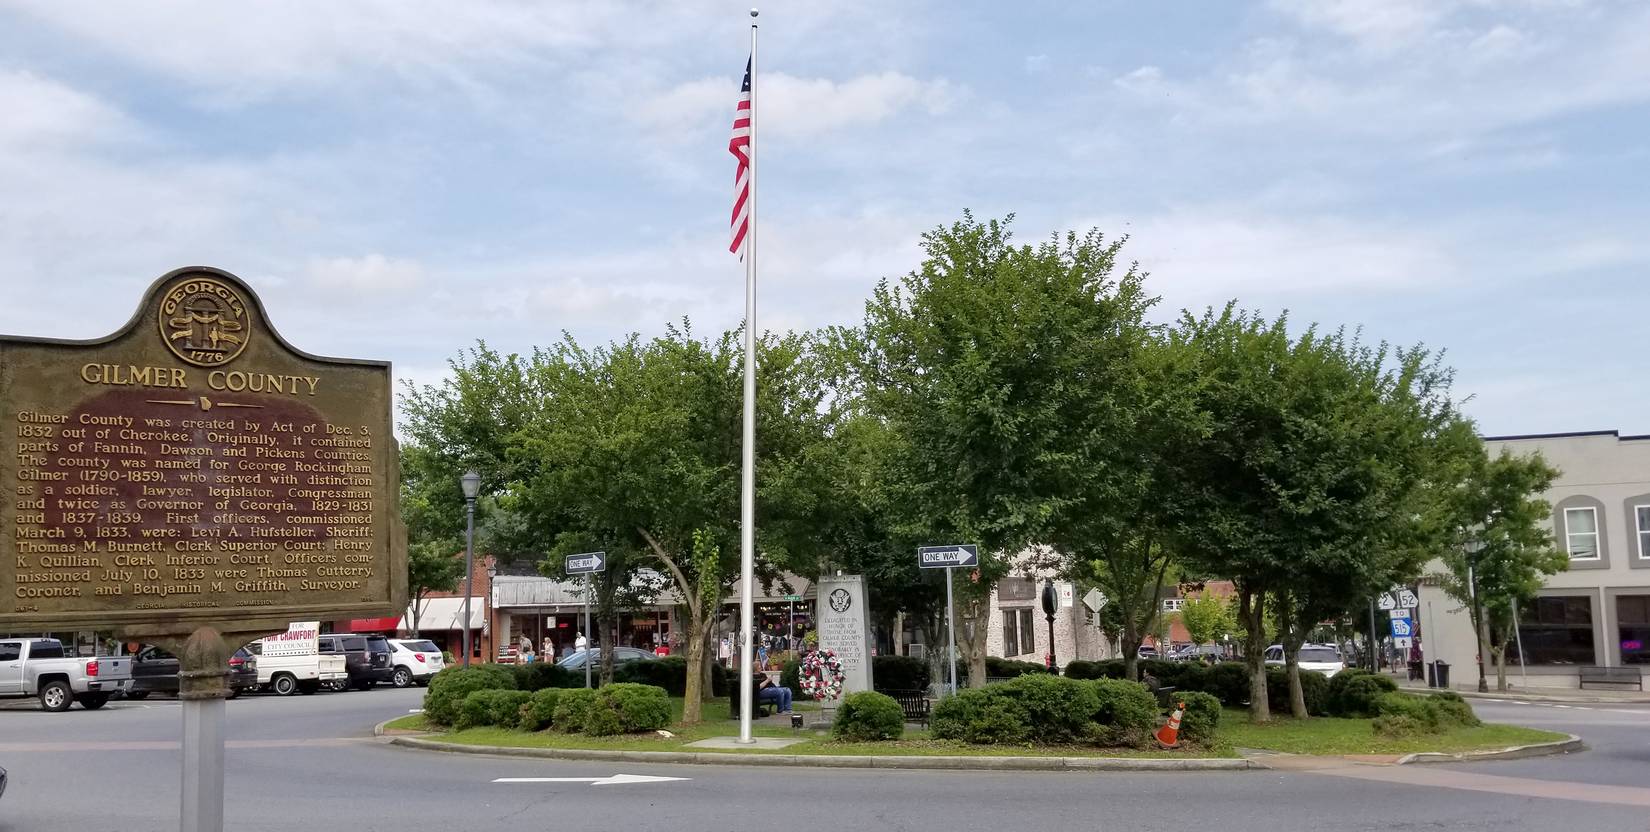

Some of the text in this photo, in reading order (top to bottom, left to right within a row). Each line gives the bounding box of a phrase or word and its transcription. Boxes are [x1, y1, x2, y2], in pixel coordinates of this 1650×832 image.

[165, 282, 243, 318] GEORGIA
[192, 351, 223, 362] 1776
[81, 364, 320, 394] GILMER COUNTY
[17, 411, 68, 424] Gilmer
[80, 414, 133, 427] County
[144, 418, 171, 427] was
[182, 418, 234, 430] created
[245, 421, 260, 432] by
[271, 422, 293, 432] Act
[303, 424, 316, 433] of
[360, 426, 372, 436] 3,
[18, 426, 371, 448] 1832 out of Cherokee. Originally, it contained
[18, 442, 59, 453] parts
[69, 442, 85, 452] of
[94, 442, 147, 454] Fannin,
[161, 444, 213, 456] Dawson
[223, 448, 246, 457] and
[256, 448, 305, 459] Pickens
[17, 455, 372, 475] The county was named for George Rockingham
[17, 470, 372, 486] Gilmer (1790-1859), who served with distinction
[17, 486, 32, 494] as
[45, 487, 53, 495] a
[65, 485, 119, 496] soldier,
[209, 487, 274, 498] legislator,
[288, 488, 372, 500] Congressman
[16, 498, 372, 513] and twice as Governor of Georgia, 1829-1831
[16, 513, 372, 524] and 1837-1839. First officers, commissioned
[16, 527, 65, 539] March
[74, 527, 87, 538] 9,
[97, 527, 131, 538] 1833,
[141, 528, 181, 538] were:
[192, 527, 220, 537] Levi
[228, 527, 242, 537] A.
[251, 527, 316, 537] Hufsteller,
[16, 542, 76, 553] Thomas
[84, 541, 100, 552] M.
[108, 540, 165, 552] Burnett,
[175, 540, 213, 551] Clerk
[220, 540, 277, 551] Superior
[334, 540, 372, 551] Henry
[17, 556, 31, 568] K.
[40, 555, 103, 567] Quillian,
[115, 555, 155, 566] Clerk
[166, 554, 220, 566] Inferior
[284, 554, 336, 564] Officers
[16, 571, 91, 582] missioned
[100, 569, 132, 582] July
[175, 568, 205, 579] 1833
[215, 569, 247, 577] were
[257, 567, 308, 577] Thomas
[317, 566, 373, 577] Gutterry,
[16, 580, 360, 598] Coroner, and Benjamin M. Griffith, Surveyor.
[1402, 595, 1414, 605] 52
[1395, 624, 1406, 633] 515
